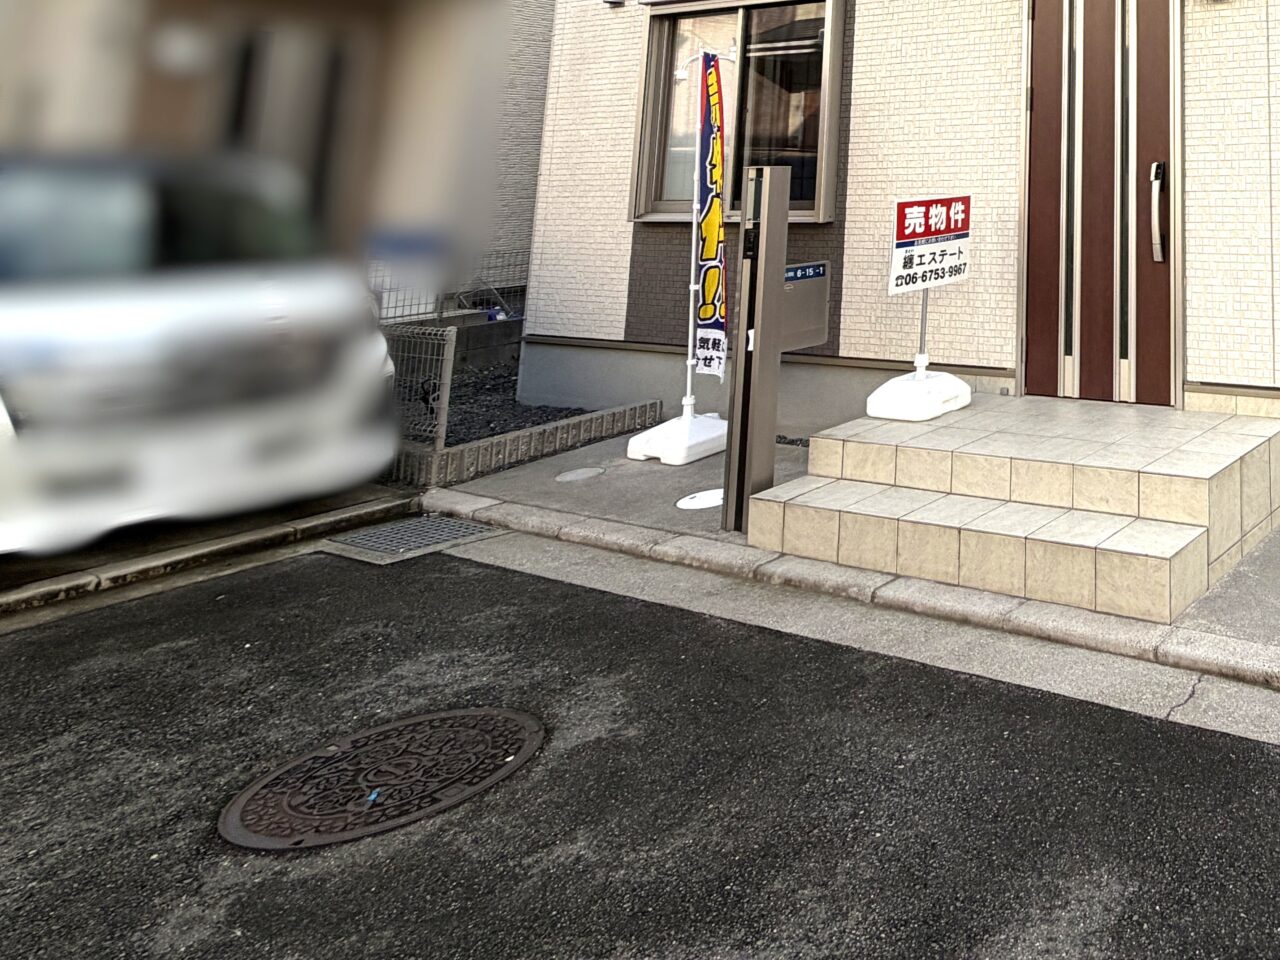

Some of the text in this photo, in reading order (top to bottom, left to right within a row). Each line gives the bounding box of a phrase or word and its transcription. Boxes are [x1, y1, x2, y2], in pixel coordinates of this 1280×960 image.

[904, 201, 965, 236] 売物件
[904, 262, 967, 286] 06-6753-9967
